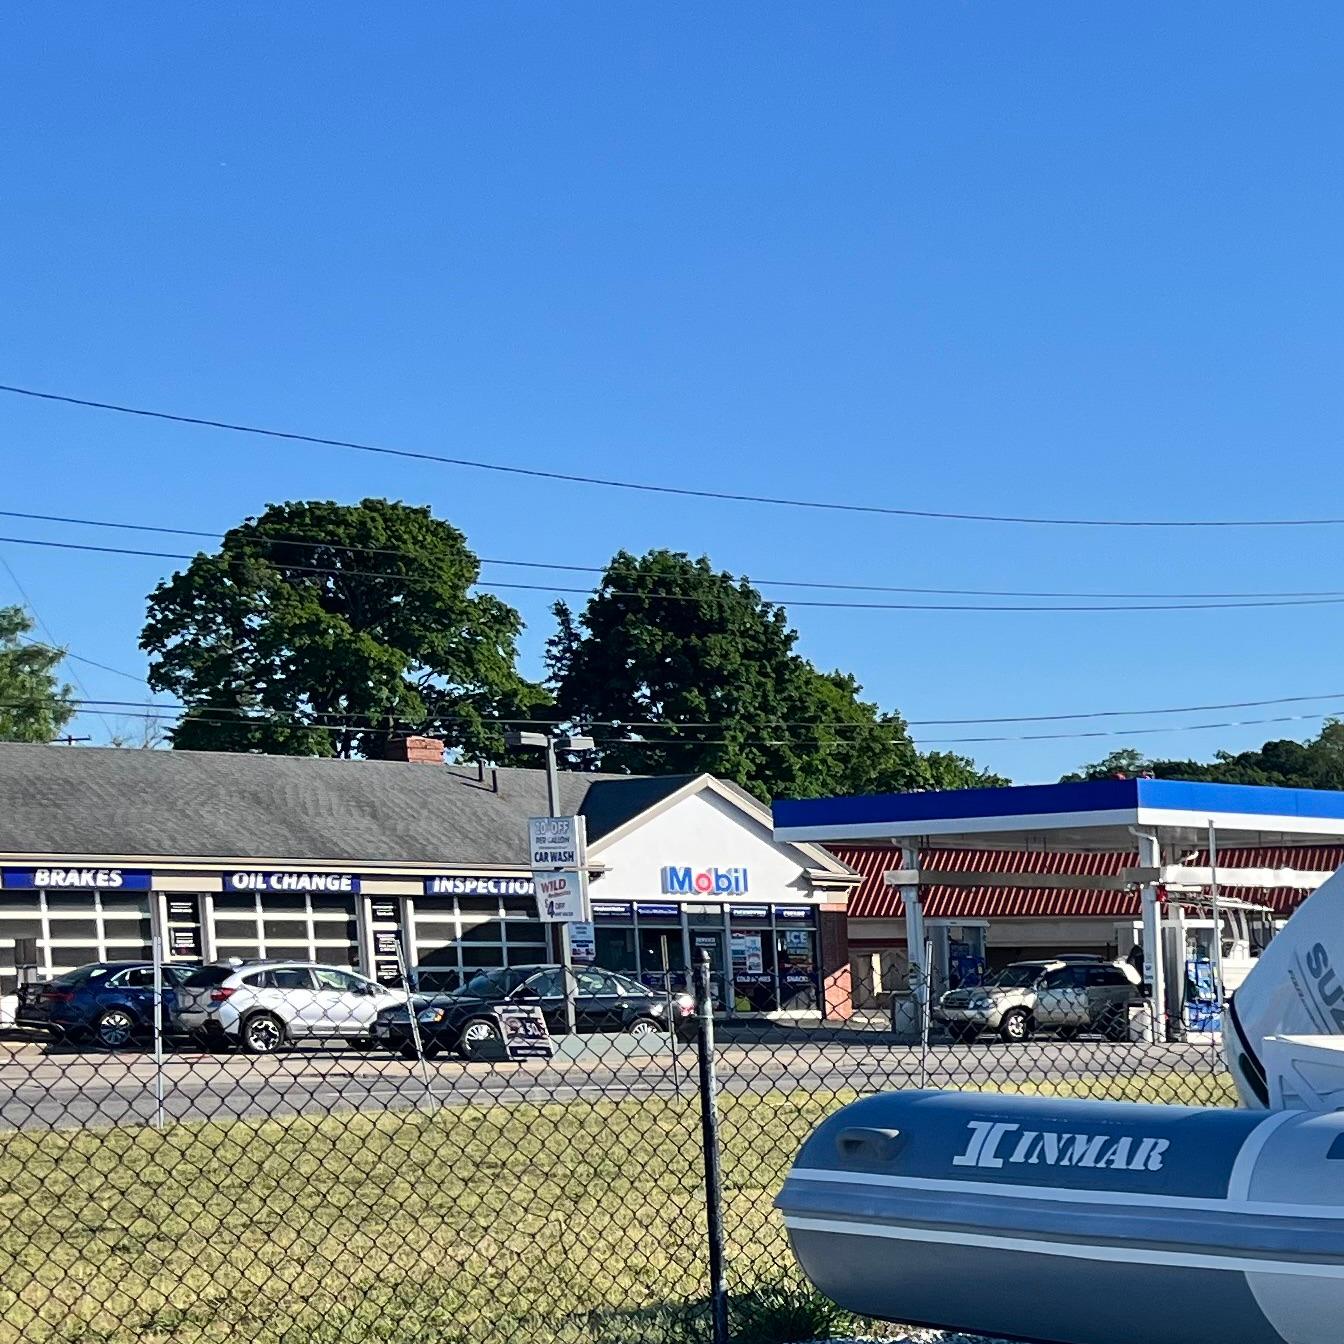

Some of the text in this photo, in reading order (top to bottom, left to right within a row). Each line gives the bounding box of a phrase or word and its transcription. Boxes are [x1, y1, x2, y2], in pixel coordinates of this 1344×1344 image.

[551, 821, 569, 835] OFF
[534, 851, 575, 862] CAR WASH
[34, 869, 123, 887] BRAKES
[232, 872, 352, 891] OIL CHANGE
[541, 878, 566, 893] WILD
[663, 866, 749, 894] Mobil
[786, 931, 808, 942] ICE
